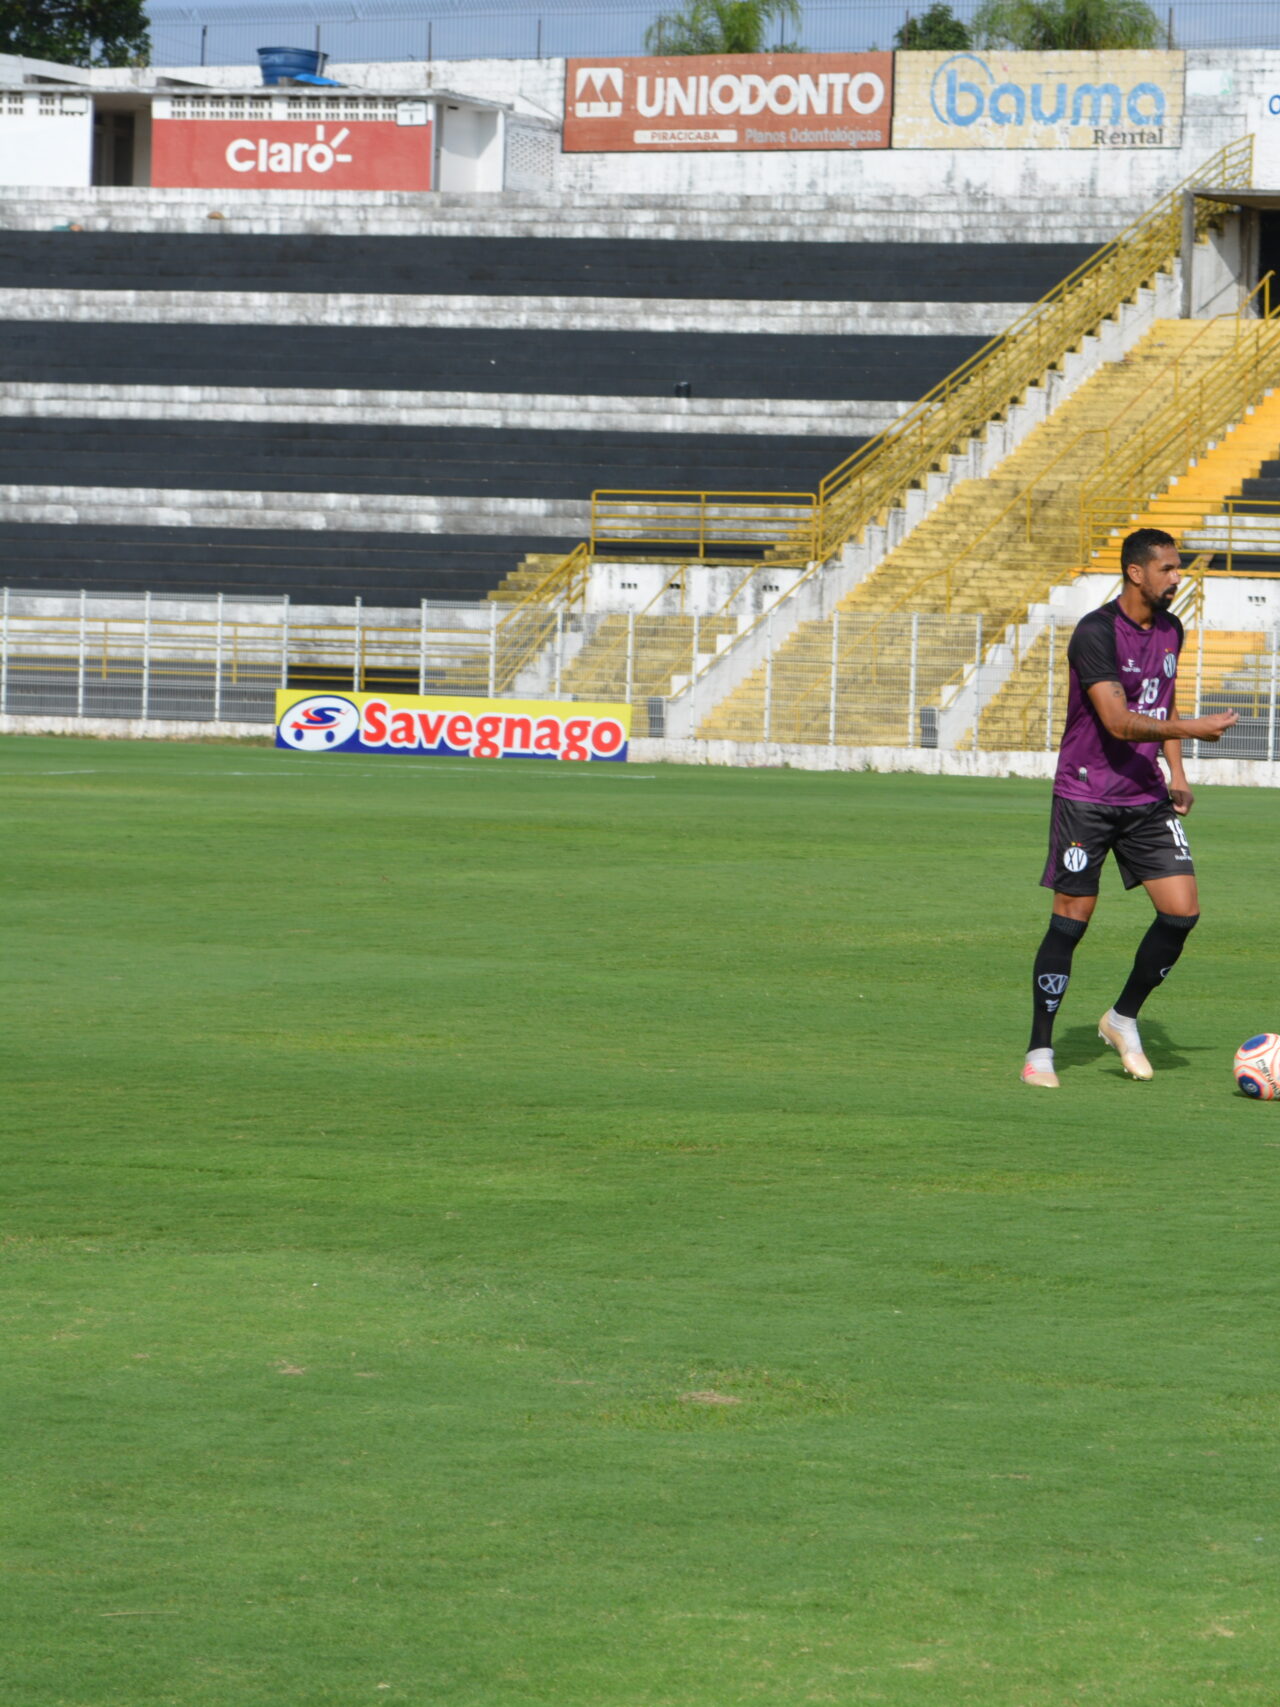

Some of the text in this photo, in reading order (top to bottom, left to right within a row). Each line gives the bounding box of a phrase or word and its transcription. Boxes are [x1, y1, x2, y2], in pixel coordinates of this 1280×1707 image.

[637, 72, 885, 117] UNIODONTO
[946, 69, 1166, 127] bauma
[650, 131, 720, 142] PIRACICABA
[745, 128, 787, 143] Planos
[1092, 128, 1164, 145] Rental
[225, 137, 335, 173] Claro
[1138, 678, 1160, 704] 18
[363, 702, 623, 761] Savegnago
